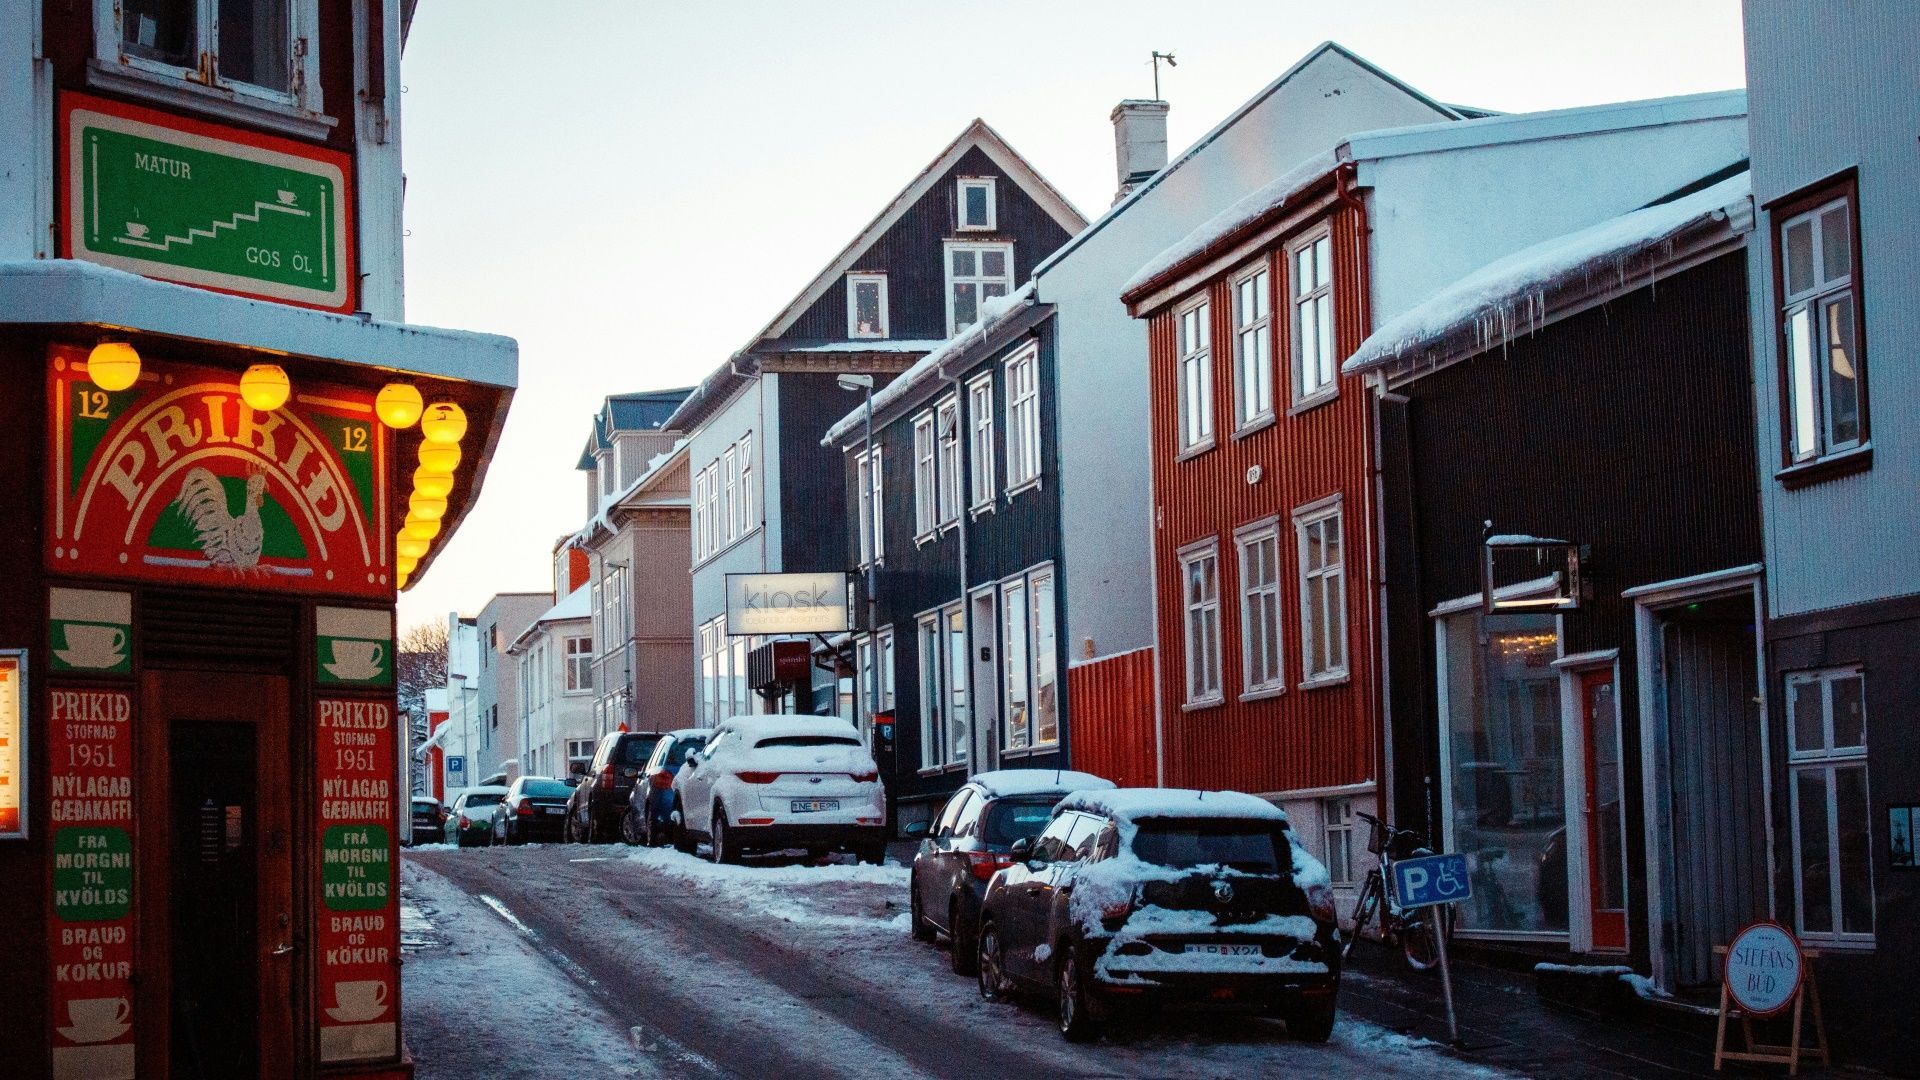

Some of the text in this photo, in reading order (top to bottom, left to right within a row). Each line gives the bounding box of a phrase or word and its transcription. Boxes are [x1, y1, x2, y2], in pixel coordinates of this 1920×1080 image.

[135, 152, 192, 180] MATUR
[246, 246, 313, 274] GOS ÖL
[78, 389, 110, 420] 12
[342, 426, 368, 452] 12
[744, 582, 830, 614] kiosk
[980, 648, 990, 661] 6
[51, 691, 130, 722] PRIKIÐ
[319, 700, 389, 730] PRIKIÐ
[68, 744, 116, 768] 1951
[451, 760, 459, 770] P
[52, 773, 131, 798] NÝLAGAÐ
[322, 775, 390, 799] NÝLAGAÐ
[51, 799, 132, 821] GÆÐAKAFFI
[322, 799, 390, 820] GÆÐAKAFFI
[343, 831, 369, 845] FRÁ
[56, 852, 130, 869] MORGNI
[324, 848, 389, 864] MORGNI
[82, 871, 104, 886] TIL
[347, 866, 366, 879] TIL
[325, 879, 388, 898] KVÖLDS
[1404, 866, 1429, 901] P
[56, 886, 129, 906] KVÖLDS
[331, 916, 385, 933] BRAUÐ
[61, 926, 127, 946] BRAUÐ
[348, 933, 366, 946] OG
[82, 945, 103, 961] OG
[326, 945, 389, 966] KÖKUR
[1735, 946, 1794, 971] STEFÁNS
